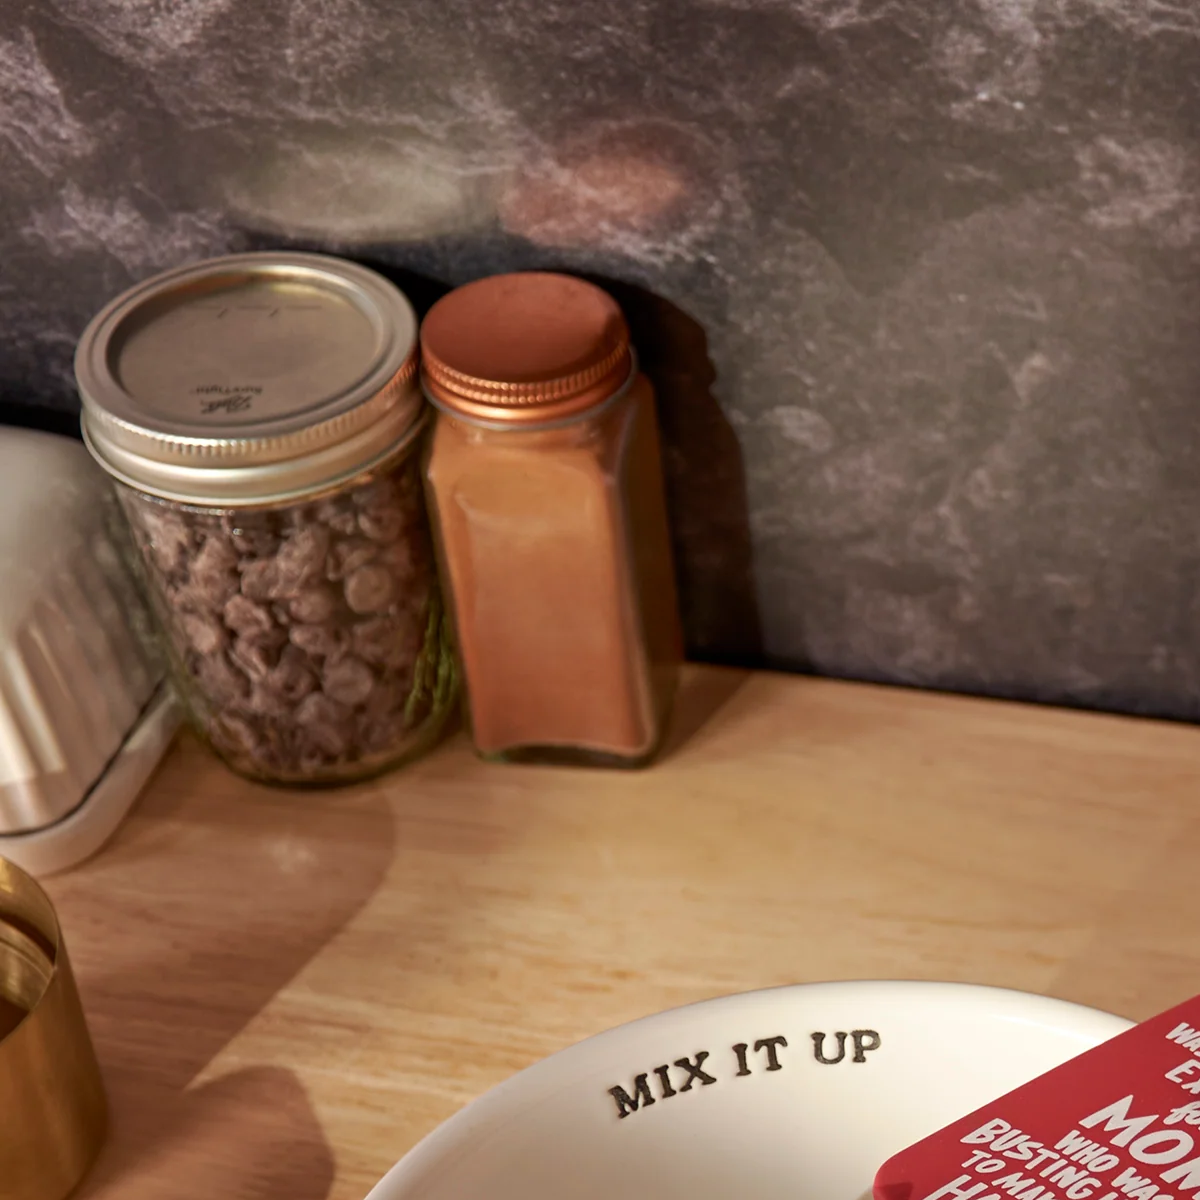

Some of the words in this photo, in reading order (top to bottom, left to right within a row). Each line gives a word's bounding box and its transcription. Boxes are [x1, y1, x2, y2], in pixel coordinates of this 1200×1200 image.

[608, 1051, 717, 1119] MIX
[732, 1036, 788, 1077] IT
[810, 1030, 881, 1065] UP
[959, 1117, 1103, 1200] BUSTING
[961, 1149, 1007, 1174] TO
[1053, 1129, 1120, 1173] WHO
